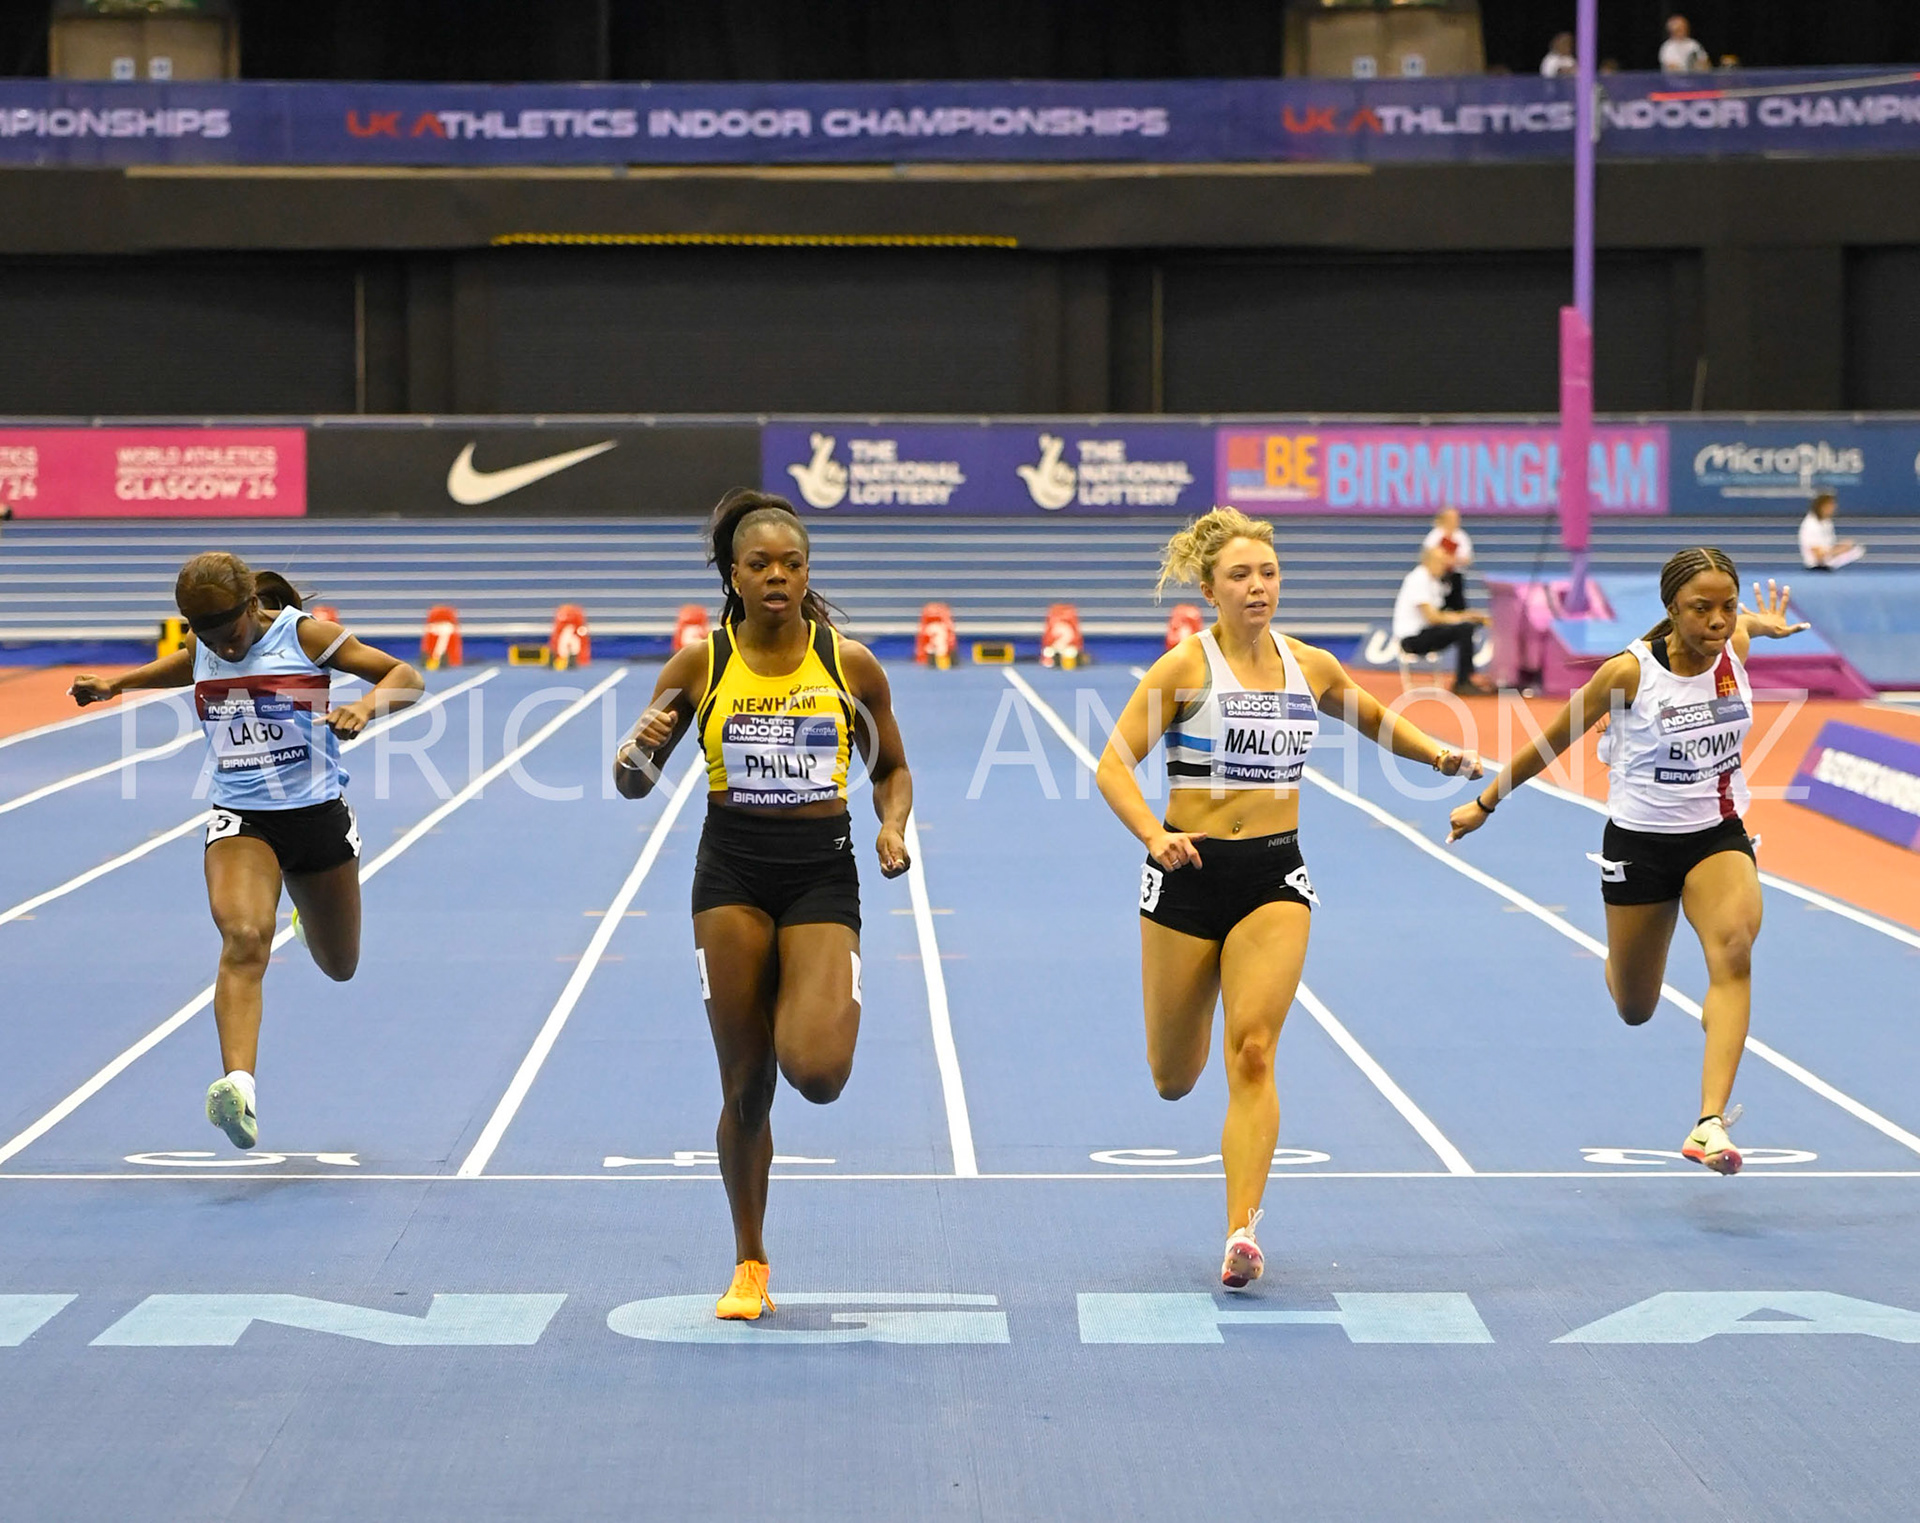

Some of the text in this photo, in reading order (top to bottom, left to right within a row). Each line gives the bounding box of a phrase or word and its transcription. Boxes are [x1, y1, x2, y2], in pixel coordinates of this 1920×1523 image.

[0, 108, 231, 138] PIONSHIPS
[346, 107, 1169, 138] UK ATHLETICS INDOOR CHAMPIONSHIPS
[1282, 93, 1920, 134] UK ATHLETICS NDOOR CHAMPI
[116, 446, 180, 466] WORLD
[848, 439, 898, 462] THE
[1077, 439, 1126, 462] THE
[850, 461, 966, 484] NATIONAL
[1078, 461, 1194, 484] NATIONAL
[1266, 436, 1658, 508] BE BIRMINGAM
[115, 476, 241, 500] GLASGOW
[849, 484, 957, 505] LOTTERY
[1077, 484, 1187, 506] LOTTERY
[208, 705, 256, 715] INDOOR
[732, 696, 817, 713] NEWHAM
[1226, 701, 1280, 712] INDOOR
[728, 723, 795, 737] INDOOR
[1662, 710, 1712, 728] INDOOR
[229, 722, 283, 746] LAGO
[728, 735, 794, 744] CHAMPIONSHIPS
[1224, 728, 1313, 756] MALONE
[1669, 730, 1740, 761] BROWN
[223, 749, 305, 769] BIRMINGHAM
[745, 754, 818, 779] PHILIP
[1660, 756, 1739, 782] BIRMINGHAM
[1216, 764, 1300, 780] BIRMINGHAM
[733, 789, 834, 804] BIRMINGHAM
[1267, 835, 1291, 848] NIKE
